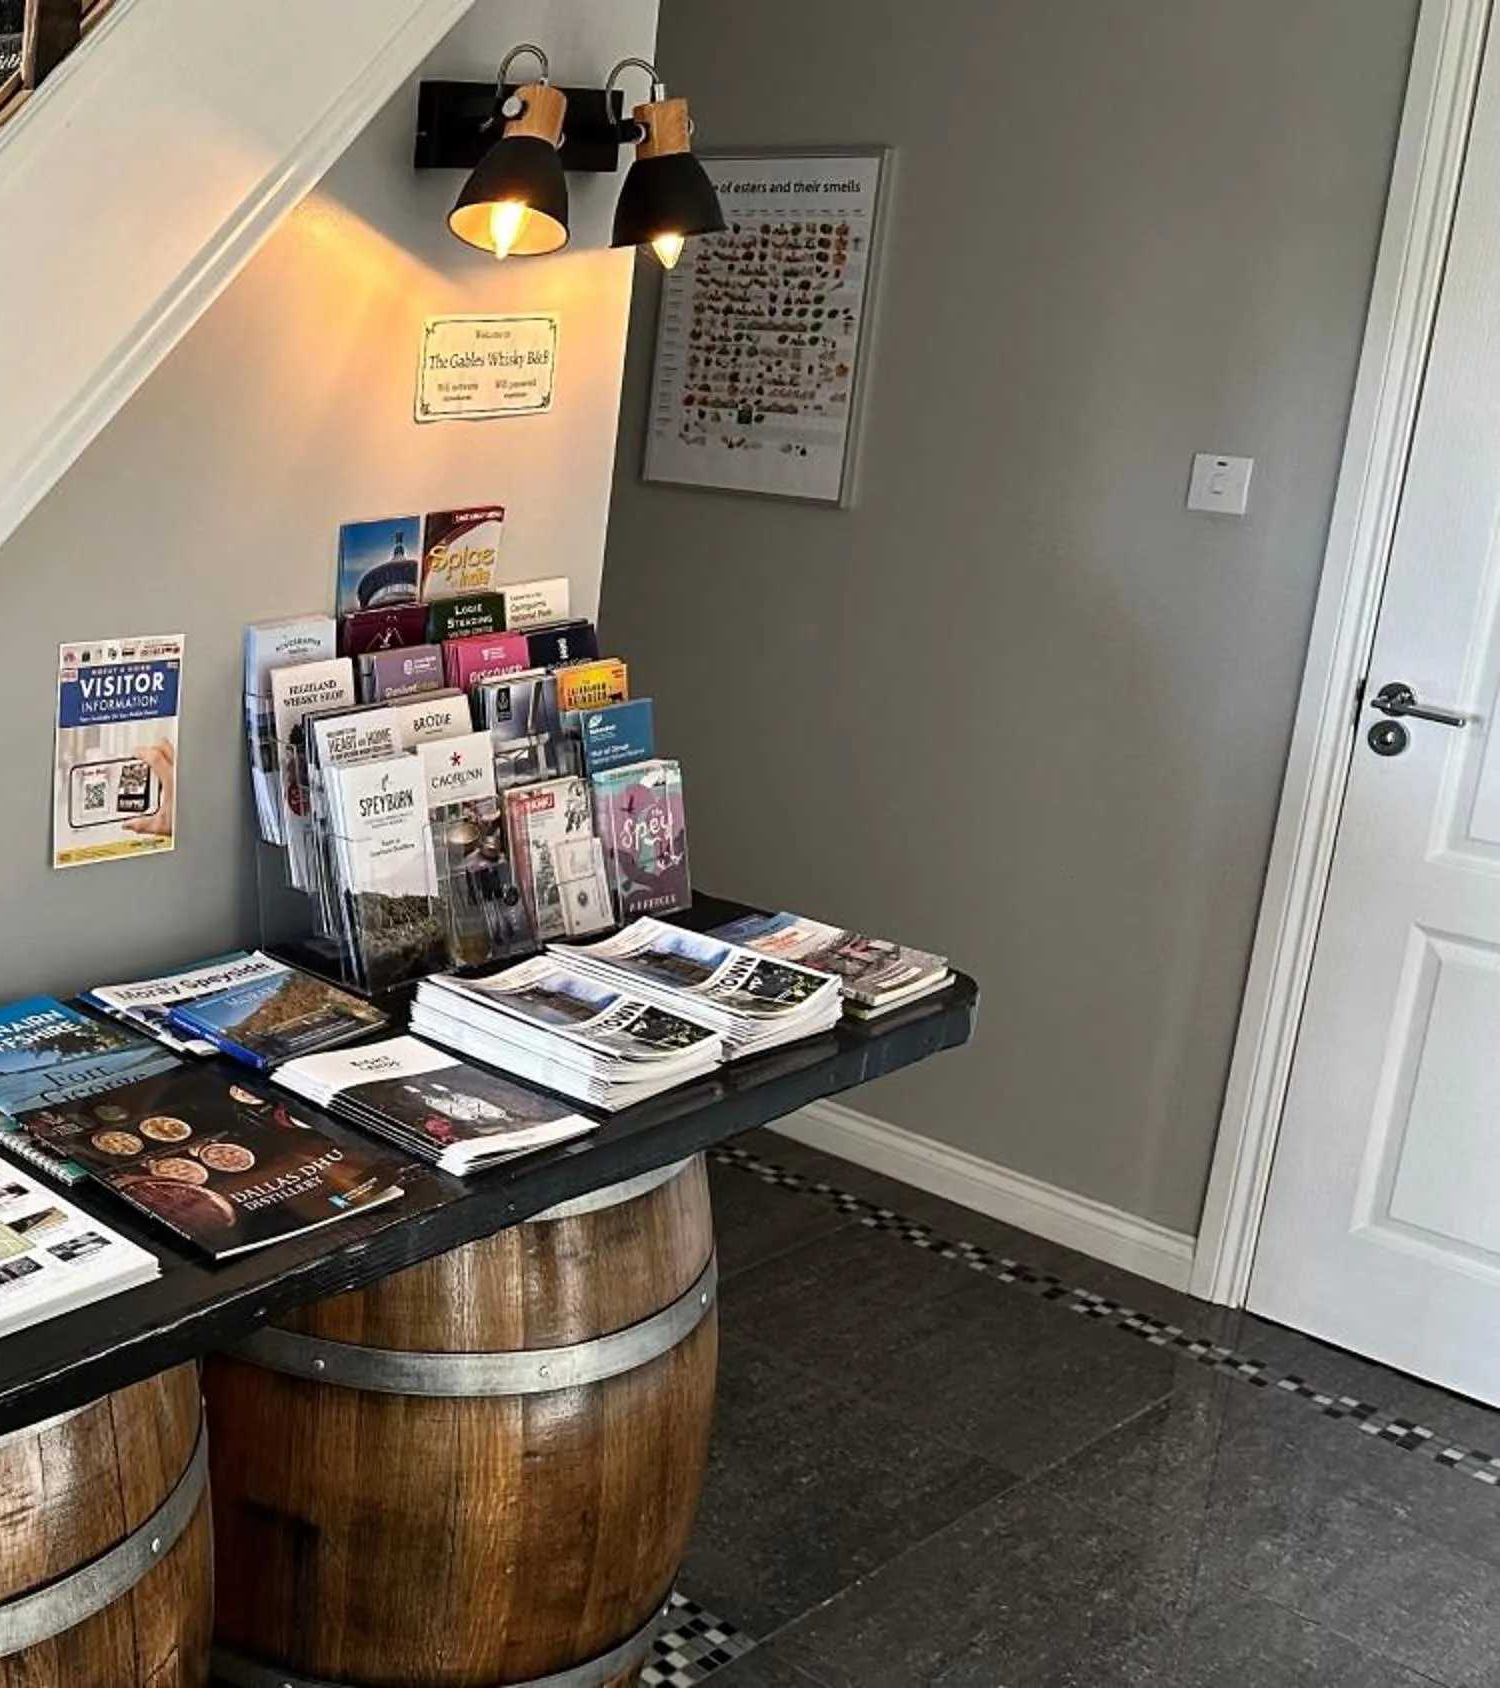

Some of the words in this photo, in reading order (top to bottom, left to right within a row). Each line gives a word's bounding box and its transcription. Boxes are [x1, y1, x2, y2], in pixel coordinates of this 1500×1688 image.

[734, 182, 767, 194] esters
[769, 181, 791, 193] and
[793, 180, 820, 193] their
[823, 180, 861, 194] smells
[429, 353, 448, 370] The
[449, 351, 485, 369] Gables
[487, 349, 525, 369] Whisky
[427, 544, 496, 581] Spice
[79, 671, 165, 698] VISITOR
[81, 695, 159, 713] INFORMATION
[413, 713, 452, 732] BRODIE
[359, 789, 414, 816] SPEYBURN
[620, 813, 673, 851] Spey
[114, 982, 182, 1001] Moray
[182, 961, 274, 992] Speyside
[43, 1065, 117, 1087] Fort
[229, 1172, 302, 1204] DALLAS
[300, 1148, 344, 1177] DHU
[243, 1175, 325, 1211] DISTILLERY
